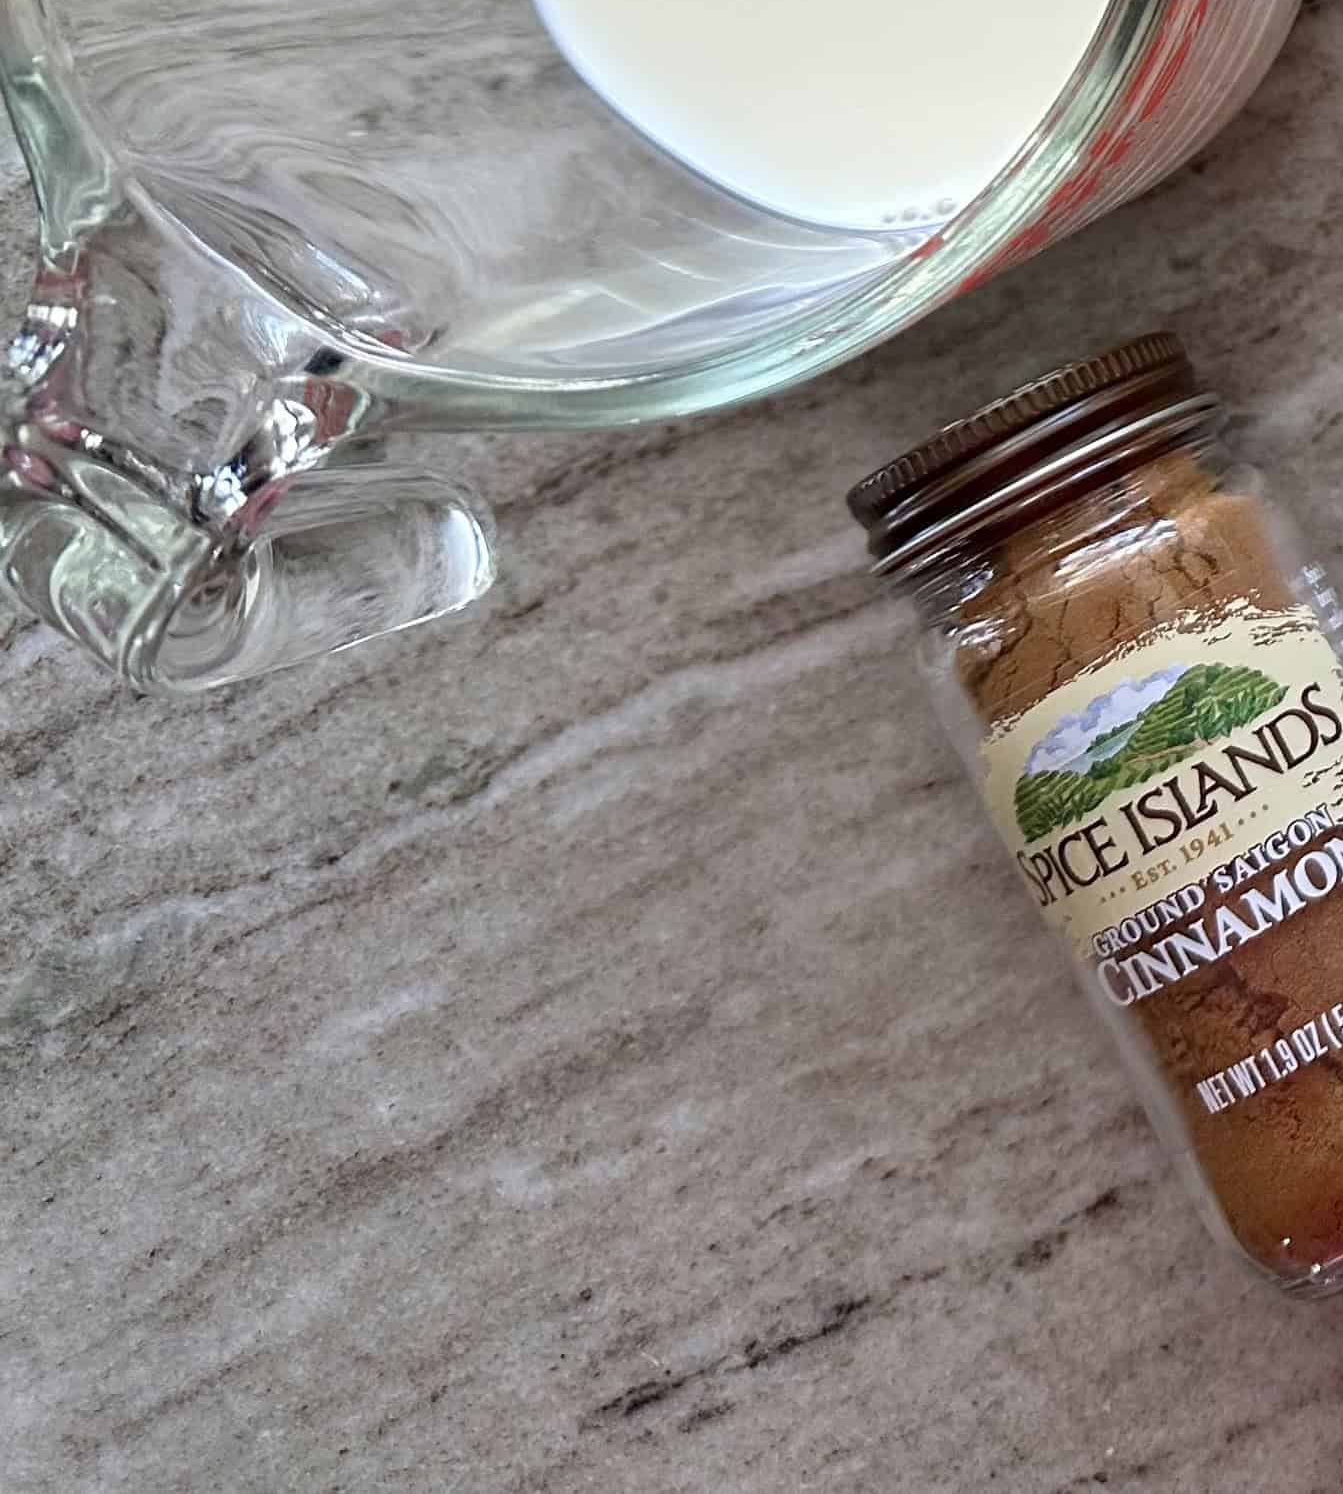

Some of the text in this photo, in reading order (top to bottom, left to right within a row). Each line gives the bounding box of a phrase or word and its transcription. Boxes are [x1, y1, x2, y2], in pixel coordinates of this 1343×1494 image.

[1016, 816, 1130, 908] SPICE
[1119, 680, 1343, 857] ISLANDS
[1180, 820, 1235, 865] 1941
[1092, 803, 1337, 958] GROUND SAIGON
[1196, 1071, 1236, 1115] NET
[1228, 1056, 1267, 1099] WT
[1261, 1038, 1299, 1082] 1.9
[1291, 1020, 1329, 1064] OZ
